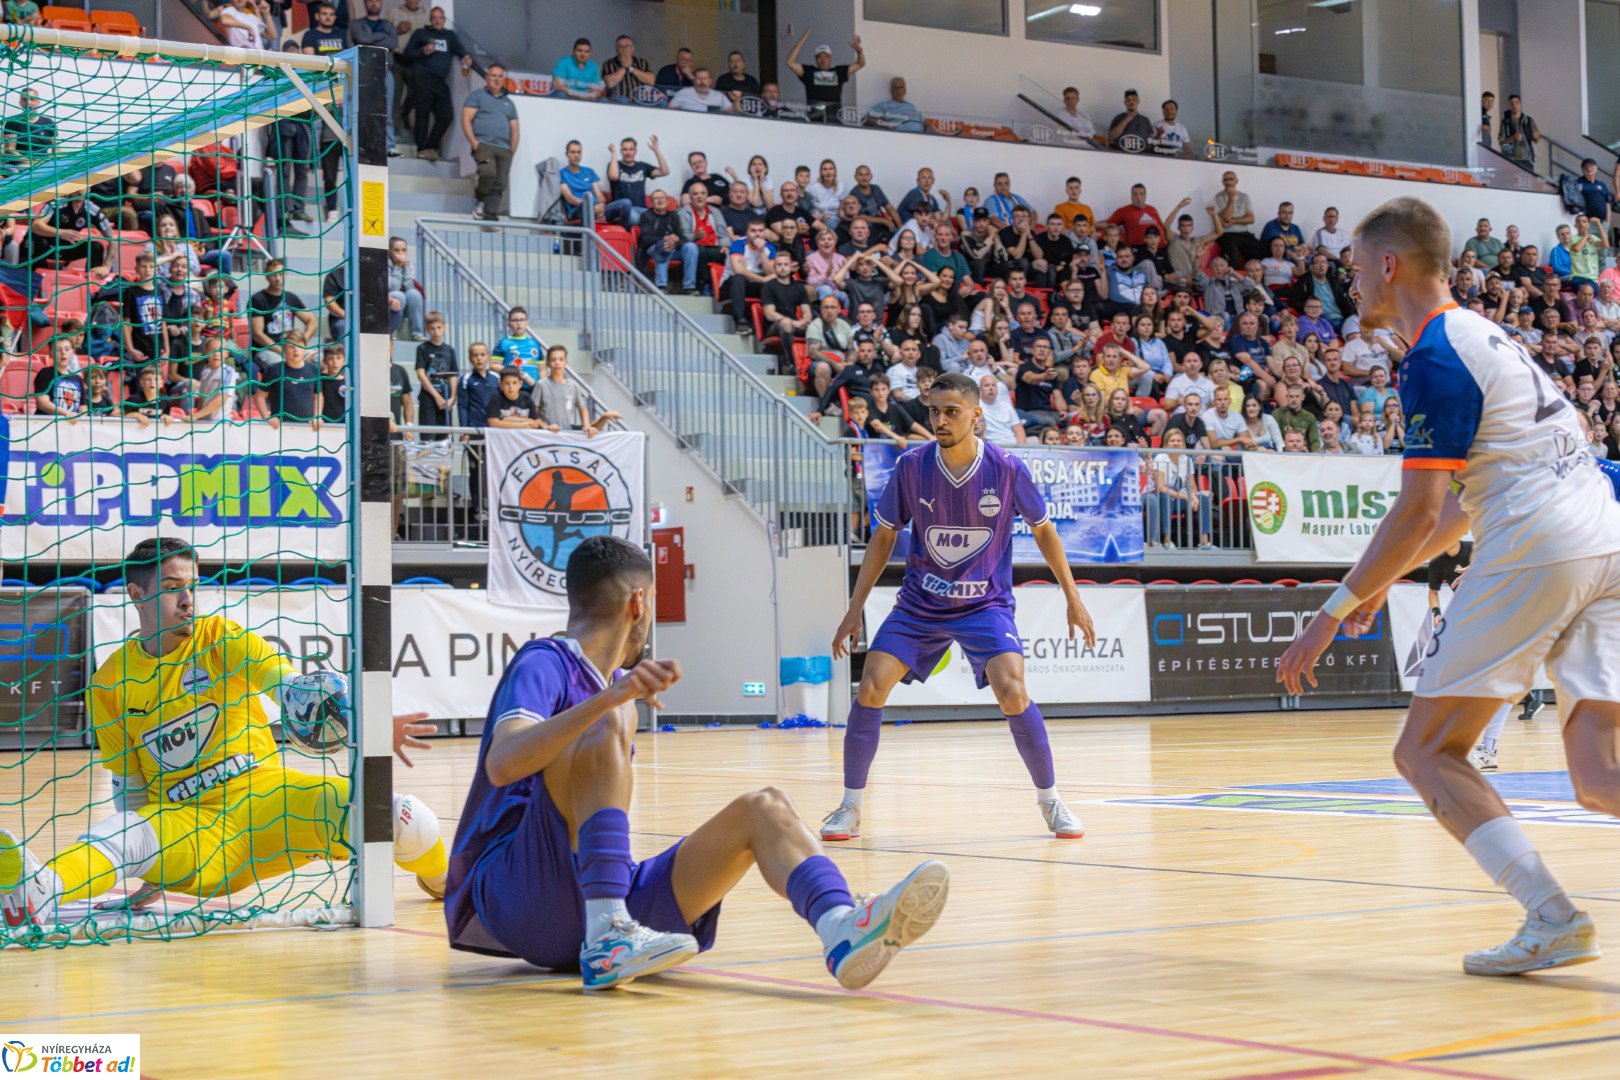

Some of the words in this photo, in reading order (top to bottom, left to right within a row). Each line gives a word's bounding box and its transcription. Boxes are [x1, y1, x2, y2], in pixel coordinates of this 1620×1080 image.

[511, 449, 615, 487] FUTSAL
[1073, 459, 1113, 485] KFT.
[1301, 522, 1345, 536] Magyar
[936, 532, 970, 548] MOL
[450, 630, 569, 677] PIN
[1346, 654, 1380, 666] KFT
[1024, 664, 1050, 674] ÁROS
[9, 680, 63, 695] KFT
[154, 721, 198, 754] MOL
